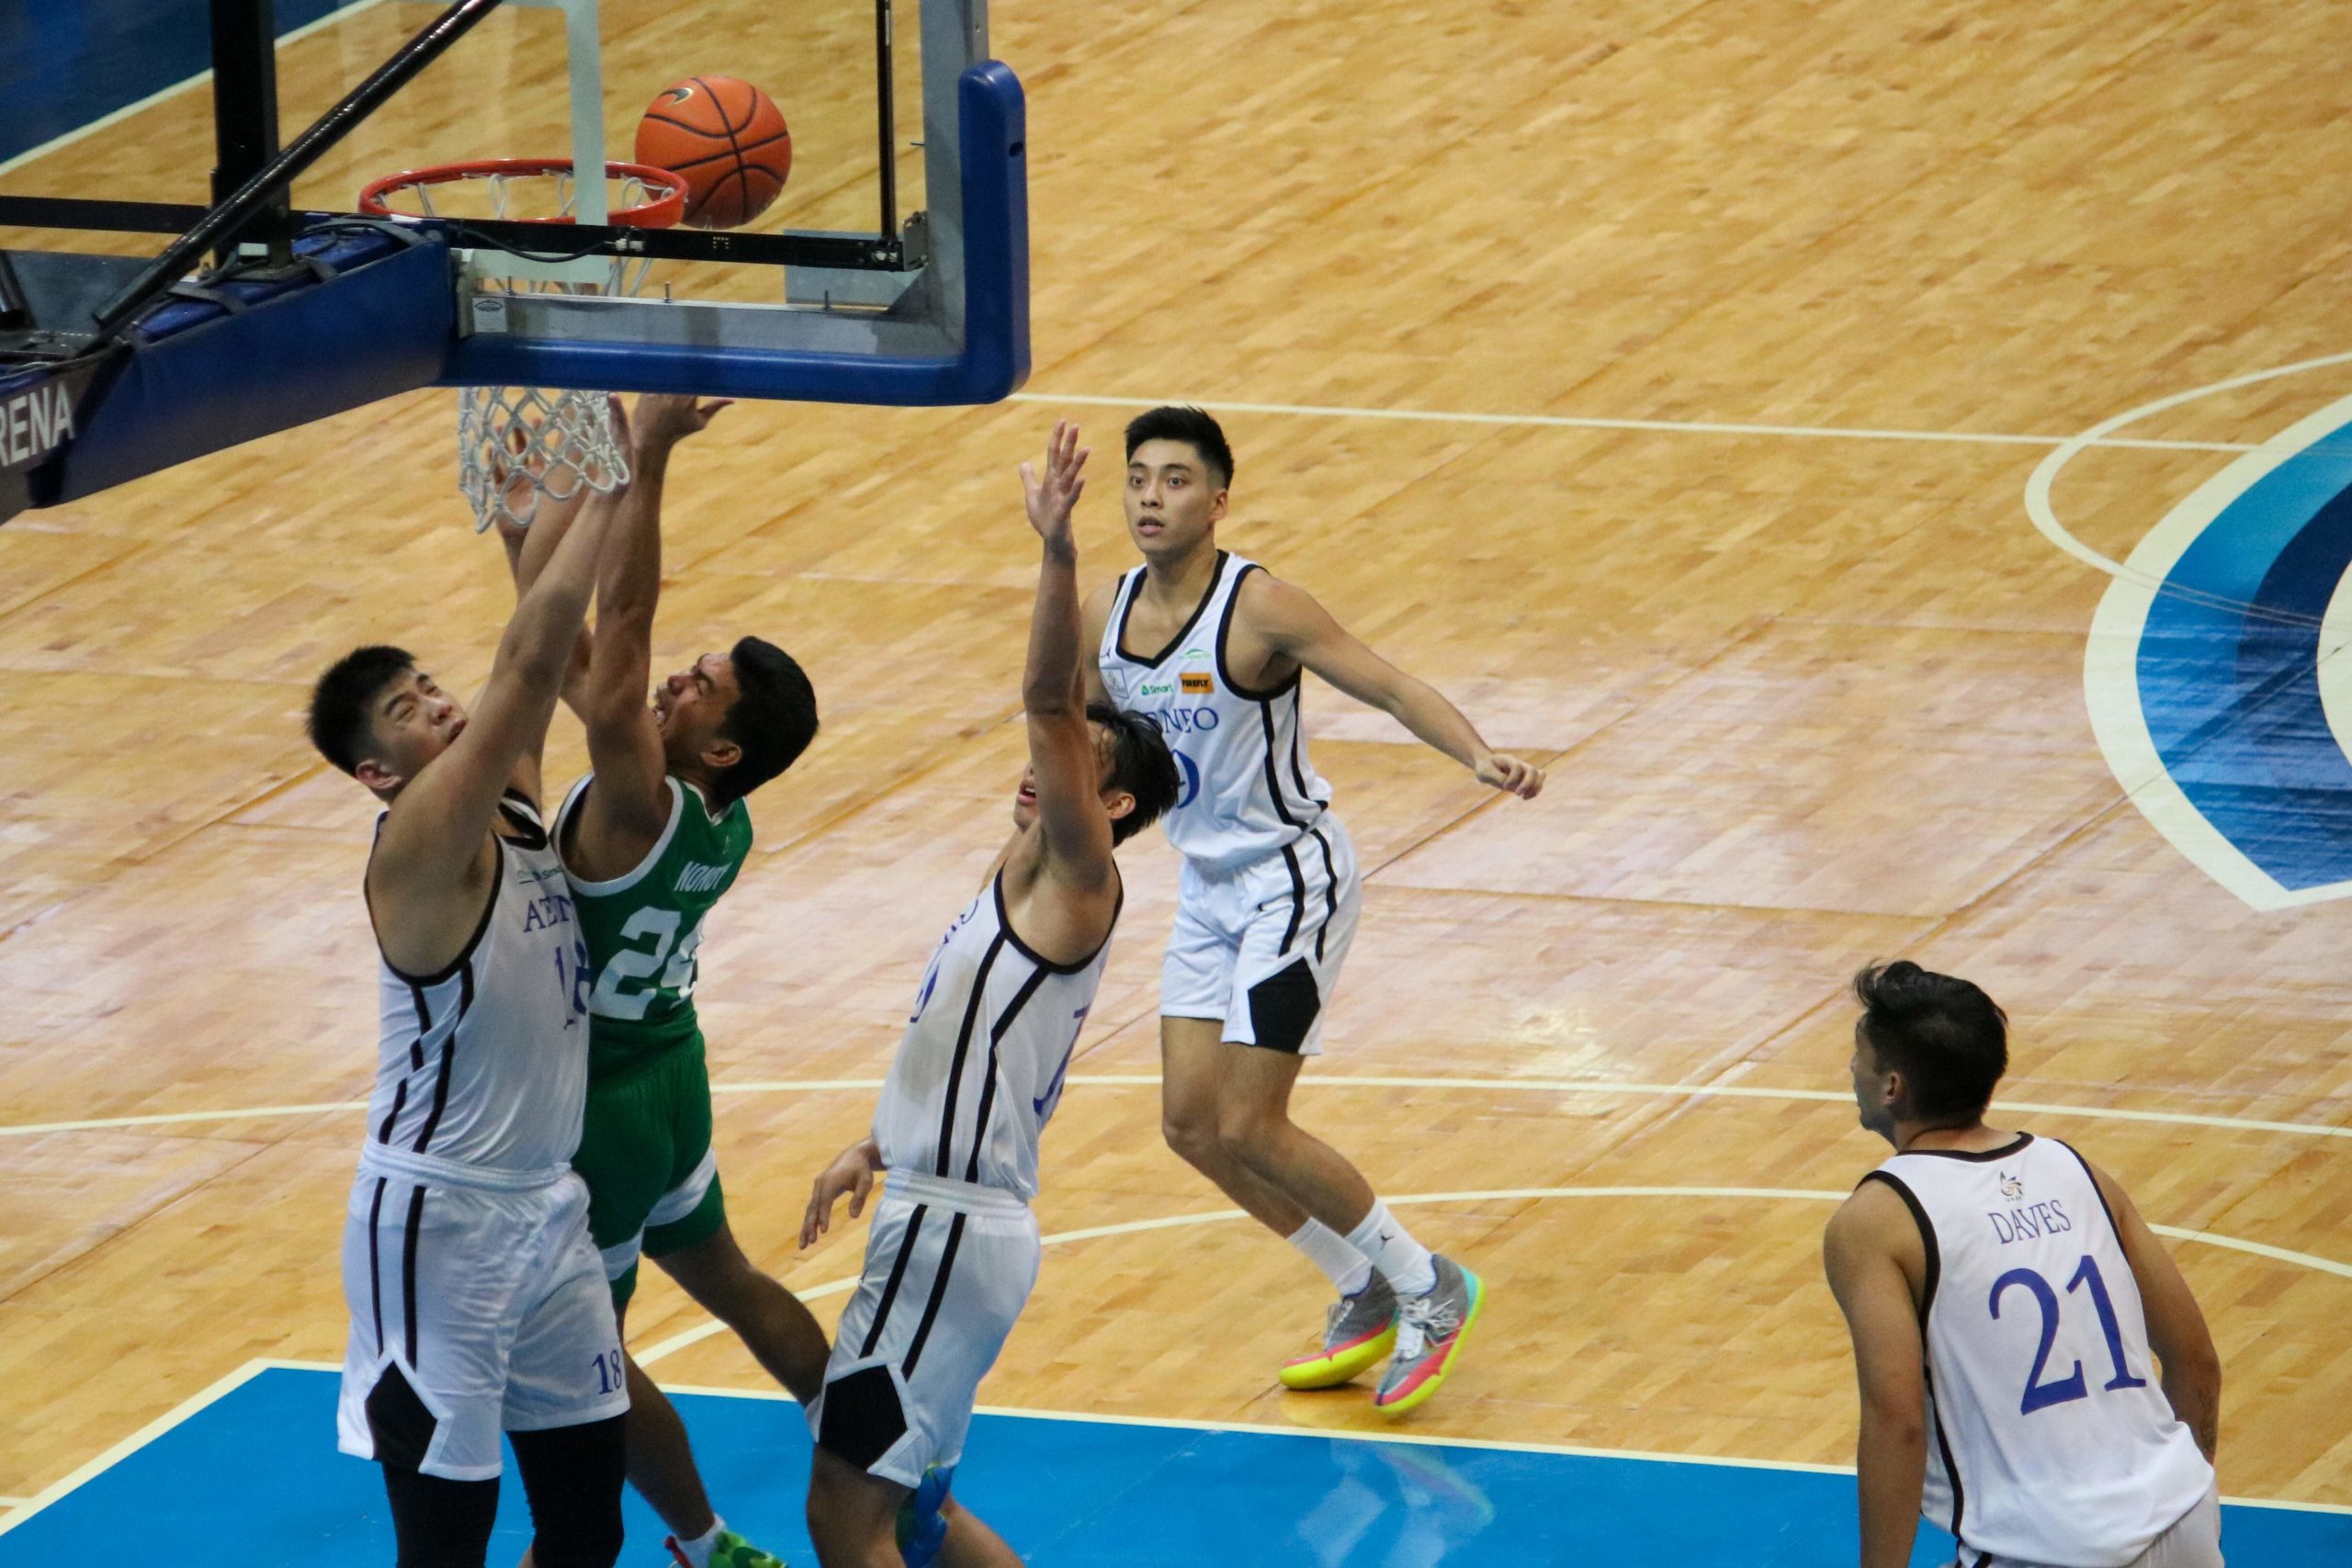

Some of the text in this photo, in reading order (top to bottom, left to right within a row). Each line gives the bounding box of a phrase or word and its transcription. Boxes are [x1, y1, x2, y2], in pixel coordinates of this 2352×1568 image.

[1149, 684, 1173, 694] Smart
[1987, 1200, 2072, 1244] DAVES
[1989, 1255, 2147, 1416] 21
[592, 1348, 622, 1395] 18
